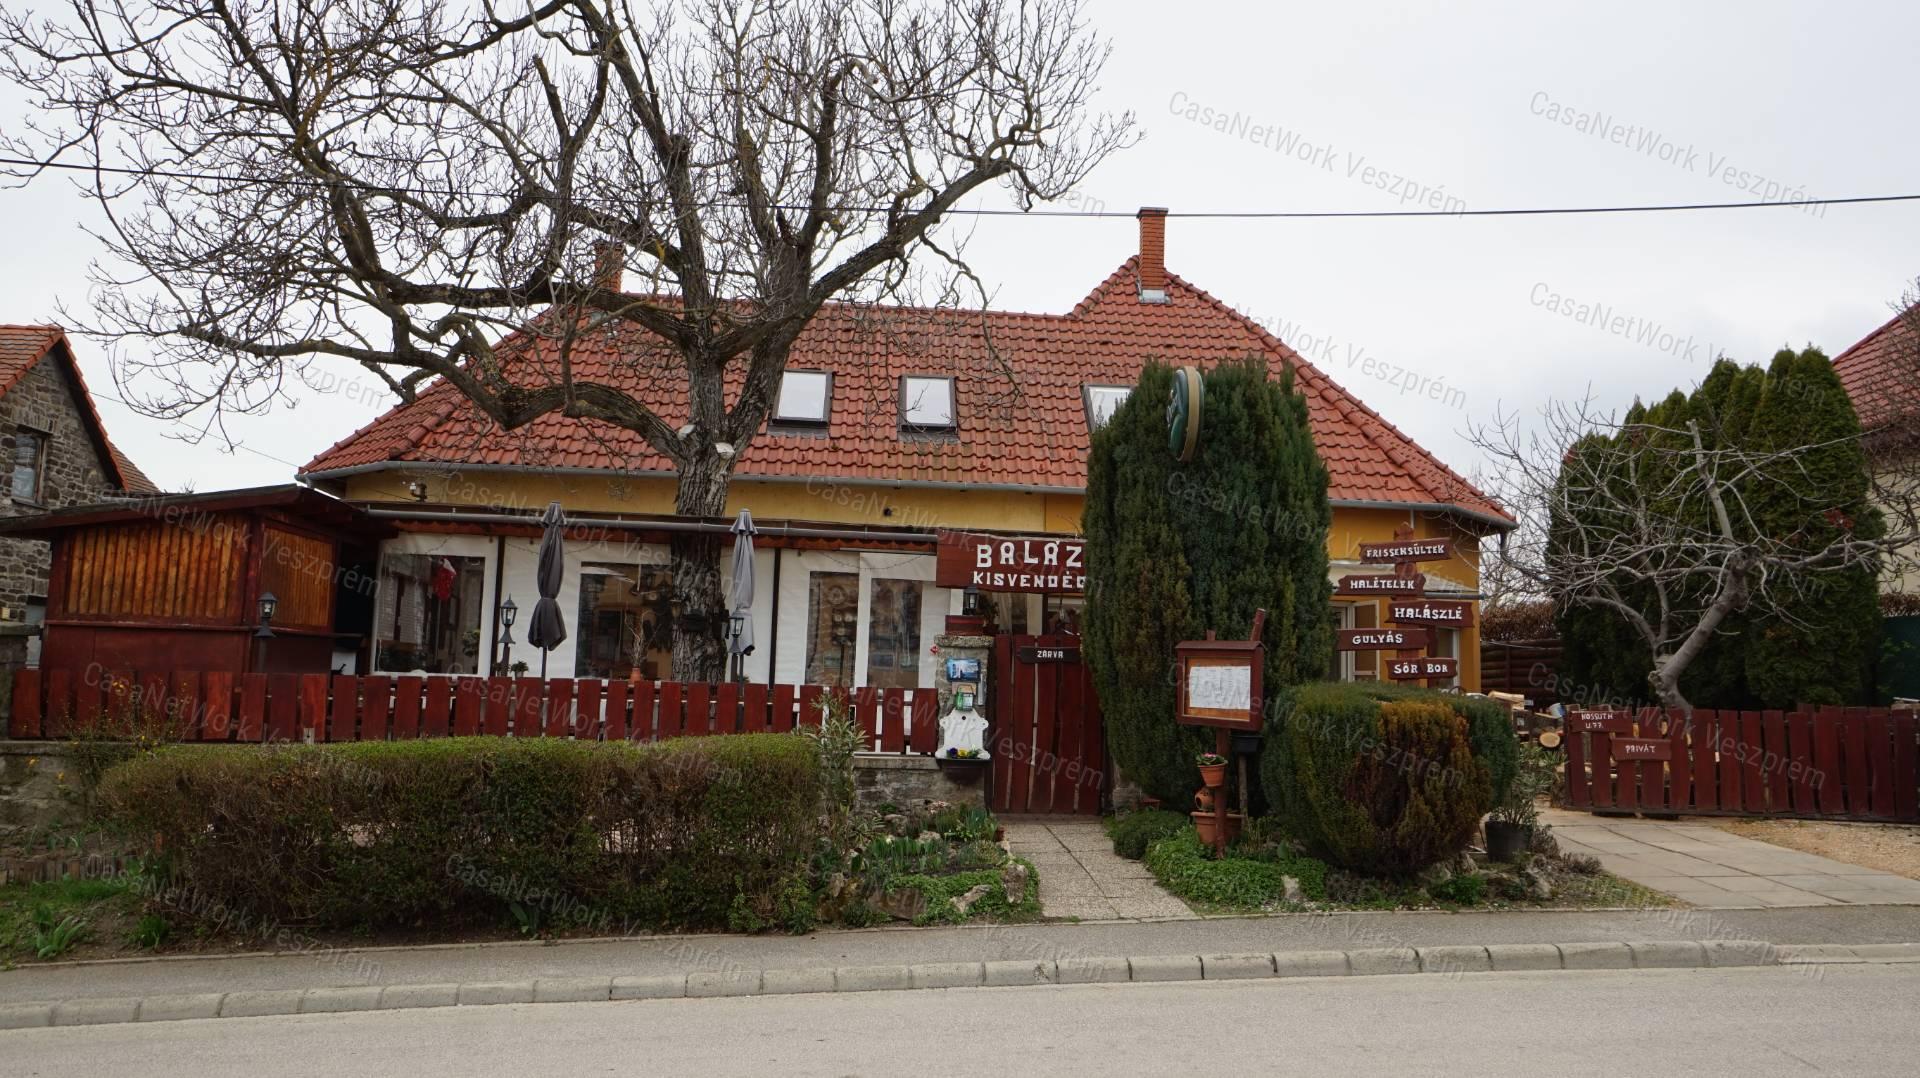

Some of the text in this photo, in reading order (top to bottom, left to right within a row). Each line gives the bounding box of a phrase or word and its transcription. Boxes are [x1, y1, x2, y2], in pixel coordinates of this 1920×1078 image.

[1350, 576, 1415, 590] HALÉTELEK
[1394, 604, 1463, 620] HALÁSZLÉ
[1352, 630, 1404, 645] GULYÁS
[1393, 661, 1448, 674] SÖR BOR
[1625, 743, 1656, 754] PRIVÁT
